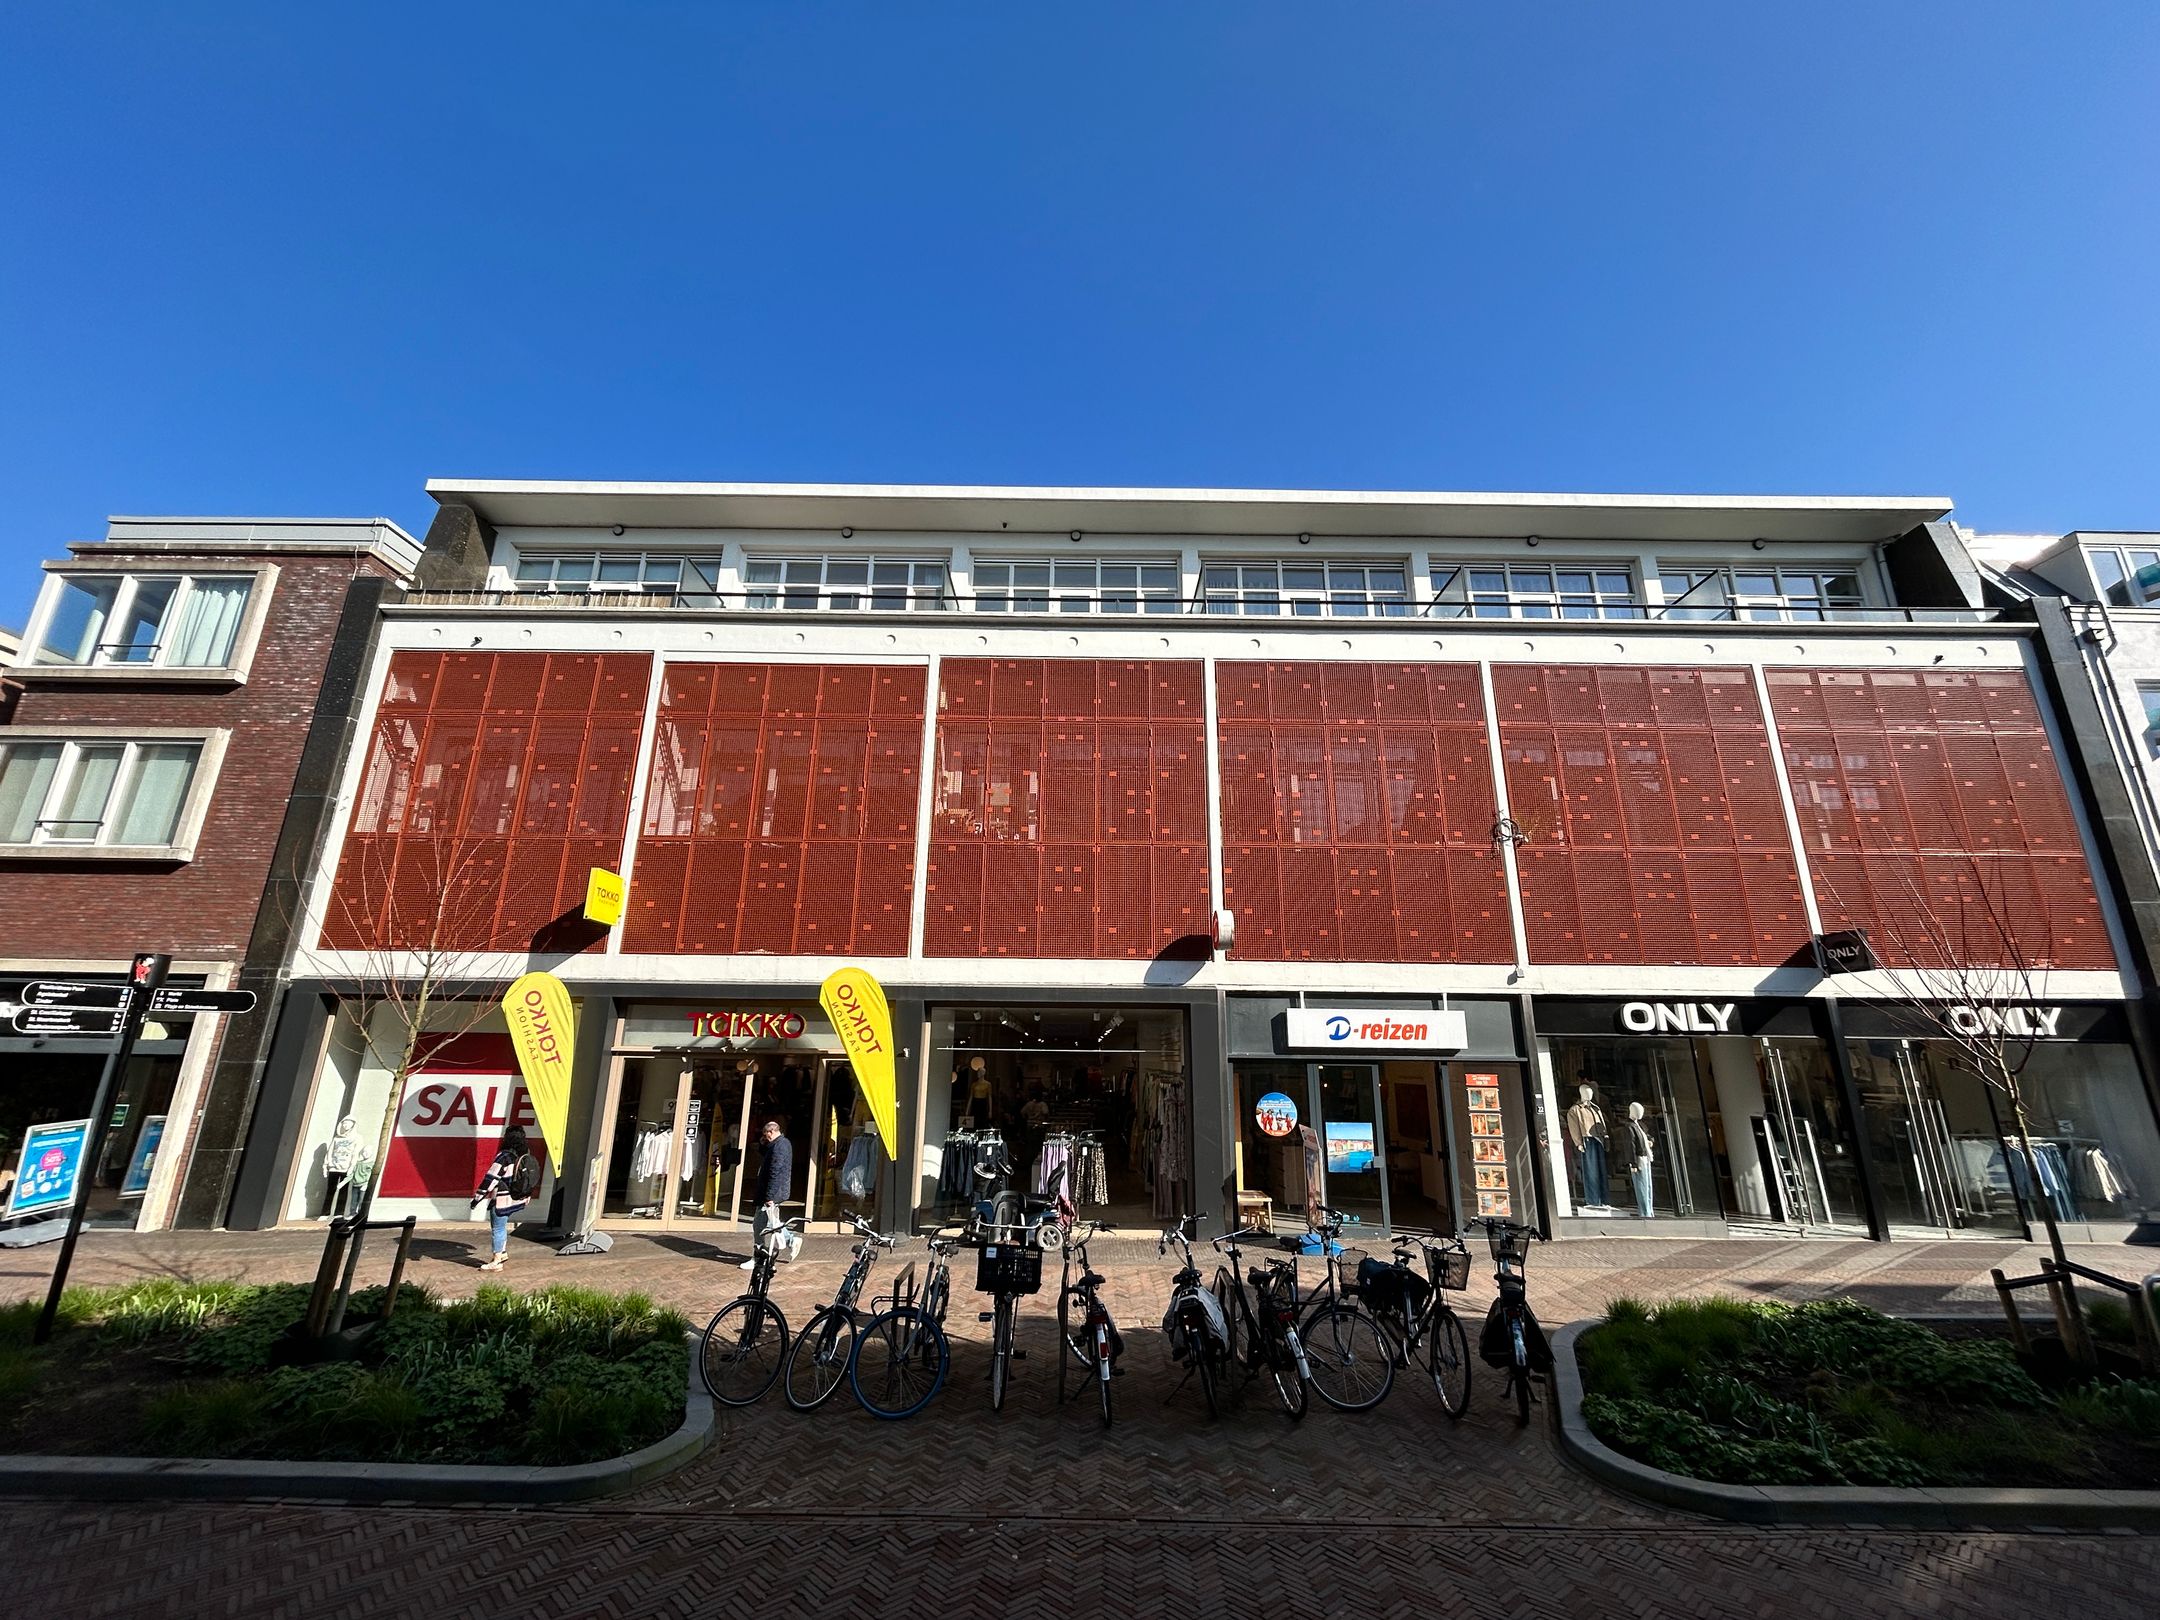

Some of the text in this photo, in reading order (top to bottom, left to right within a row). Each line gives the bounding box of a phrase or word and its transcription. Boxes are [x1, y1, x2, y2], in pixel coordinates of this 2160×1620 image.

[1827, 945, 1860, 959] ONLY
[1326, 1016, 1427, 1040] D-reizen
[1621, 1002, 1735, 1031] ONLY
[1949, 1006, 2061, 1035] ONLY
[412, 1085, 536, 1126] SALE
